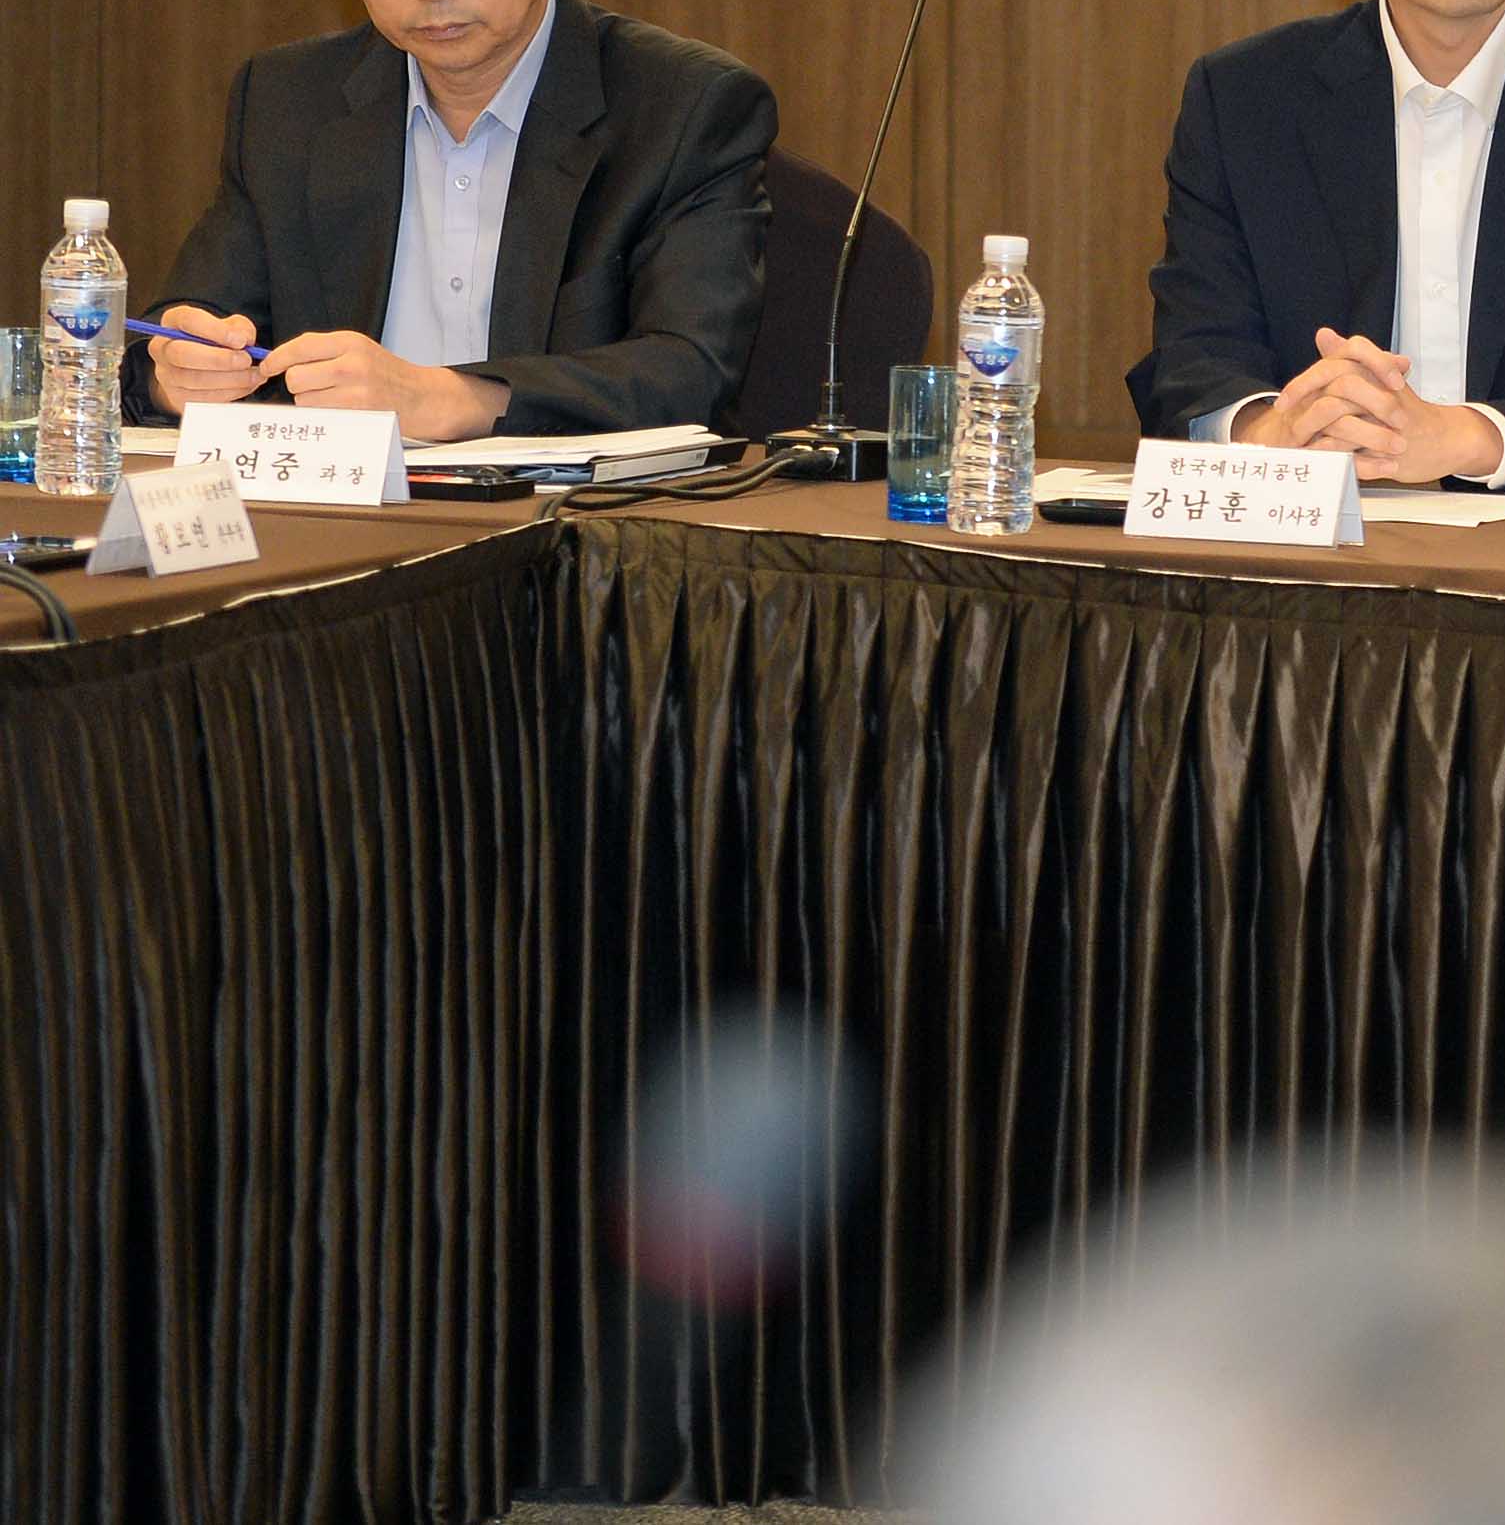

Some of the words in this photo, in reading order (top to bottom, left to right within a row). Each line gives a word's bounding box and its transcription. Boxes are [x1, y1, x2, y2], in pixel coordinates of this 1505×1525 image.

[248, 422, 327, 443] 행정안전부
[1169, 457, 1312, 483] 한국에너지공단
[1142, 488, 1248, 523] 강남훈
[1267, 505, 1323, 527] 이사장
